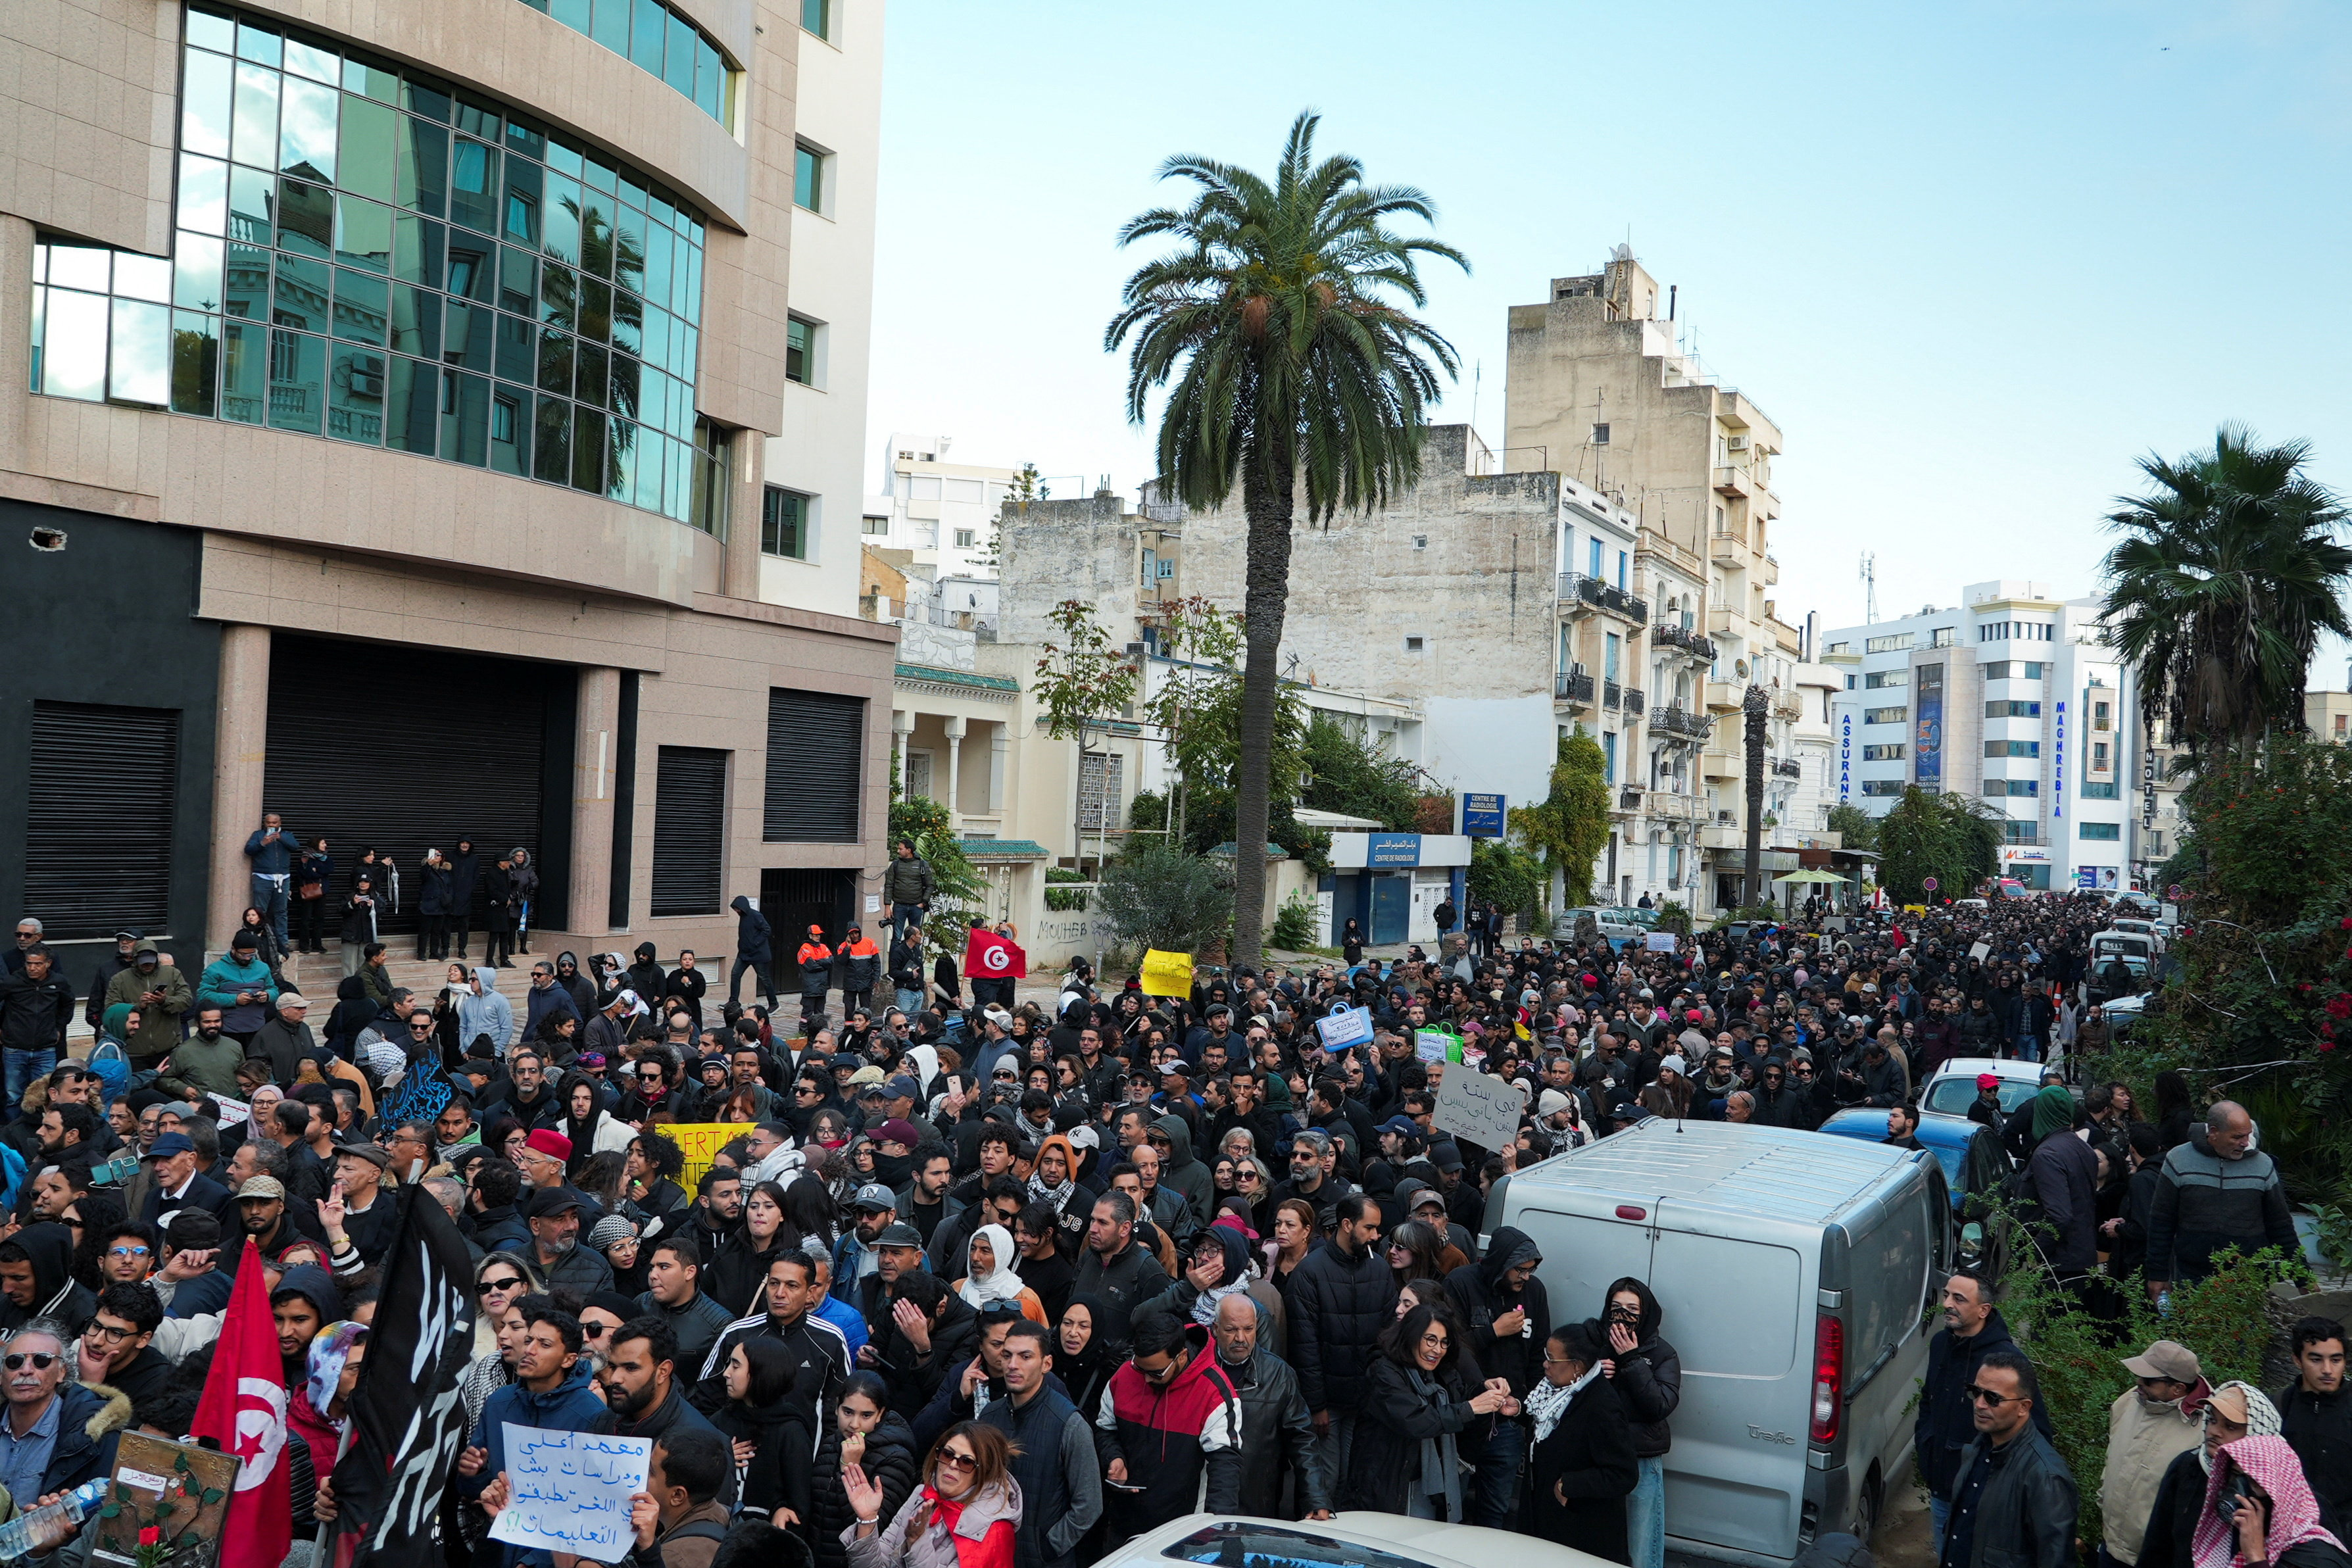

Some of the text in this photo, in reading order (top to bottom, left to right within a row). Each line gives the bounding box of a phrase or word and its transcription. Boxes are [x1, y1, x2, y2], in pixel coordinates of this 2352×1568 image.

[2054, 702, 2066, 818] MAGHREBIA
[2143, 752, 2153, 827] HOTEL
[1037, 921, 1087, 940] MOUHEB
[1462, 1081, 1517, 1117] في ستة
[583, 1441, 643, 1457] معهد
[1747, 1423, 1796, 1445] Trafic
[518, 1457, 641, 1488] ودراسات بش
[512, 1479, 576, 1505] تطبقوا
[522, 1515, 616, 1546] التعليمات
